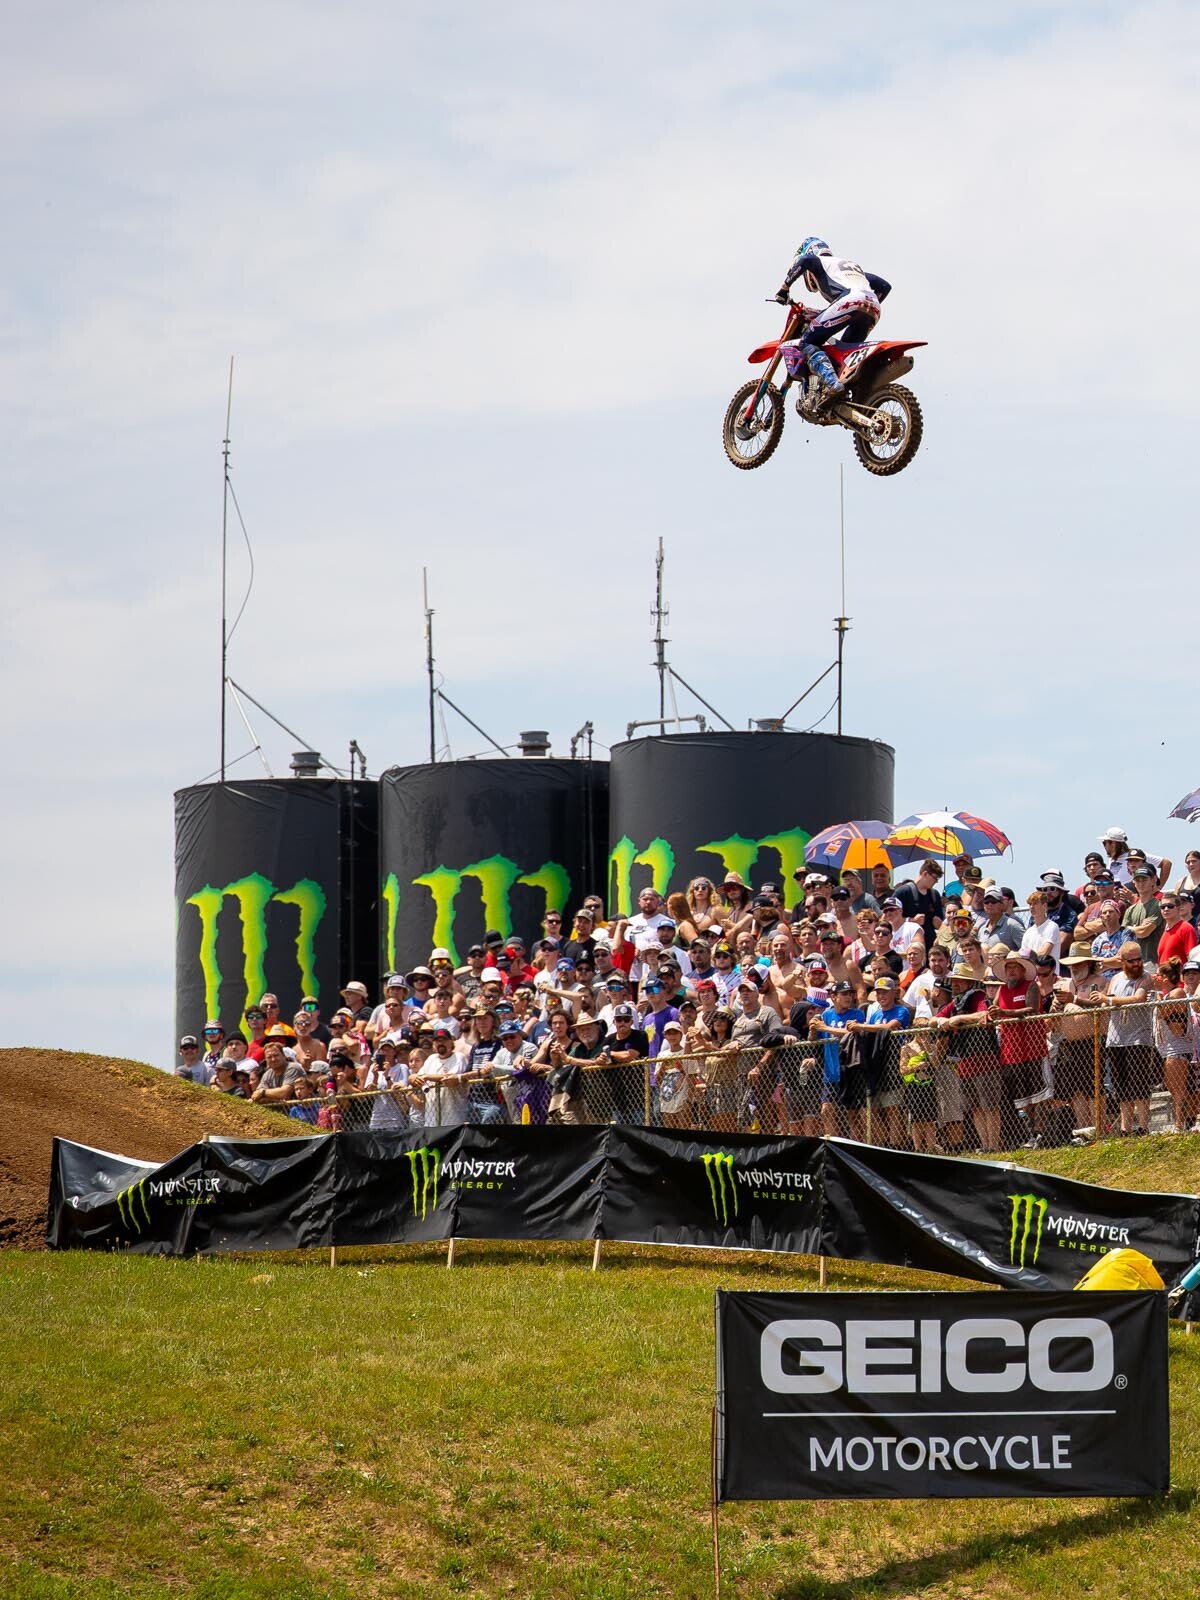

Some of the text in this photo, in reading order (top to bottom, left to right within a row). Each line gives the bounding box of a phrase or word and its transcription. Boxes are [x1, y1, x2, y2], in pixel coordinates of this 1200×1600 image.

[442, 1158, 516, 1179] MONSTER
[150, 1177, 221, 1197] MONSTER
[737, 1168, 813, 1191] MONSTER
[753, 1191, 803, 1201] ENERGY
[1047, 1215, 1130, 1245] MONSTER
[1058, 1239, 1113, 1254] ENERG
[809, 1435, 1072, 1472] MOTORCYCLE
